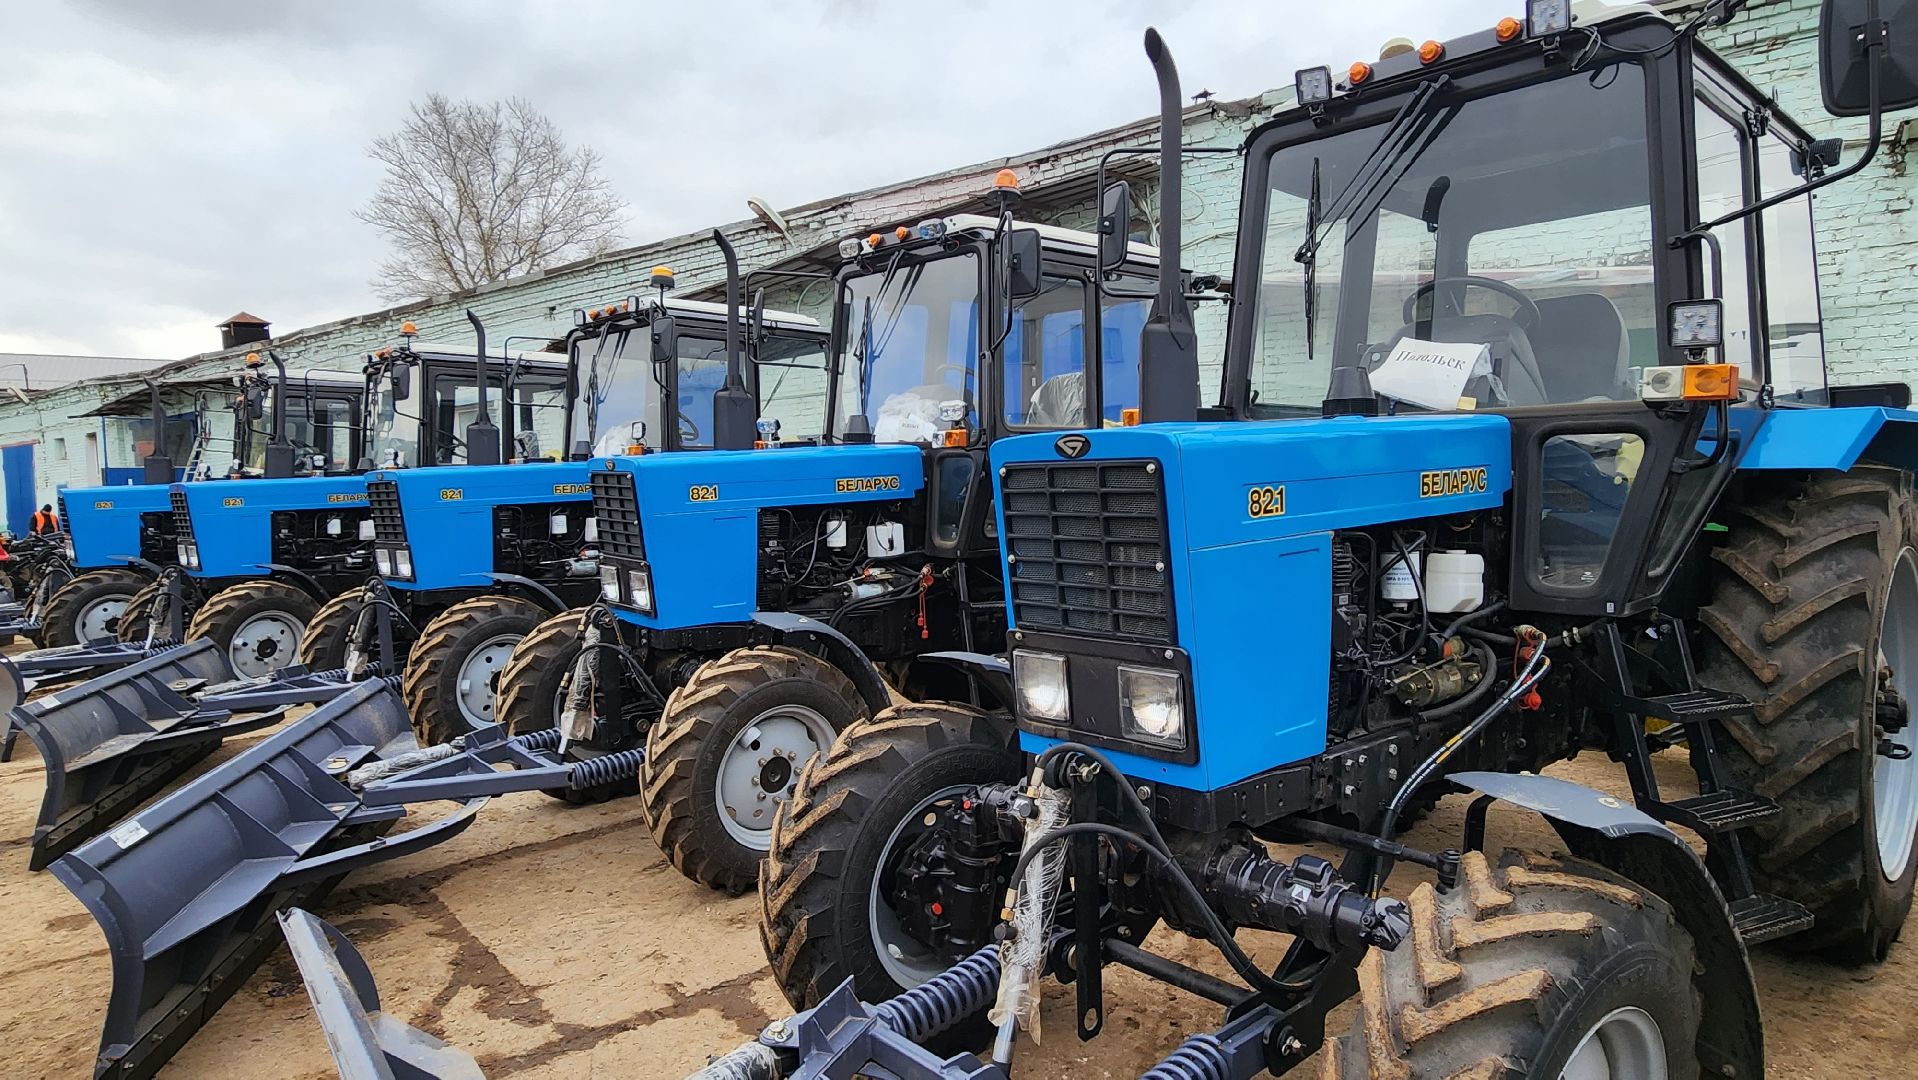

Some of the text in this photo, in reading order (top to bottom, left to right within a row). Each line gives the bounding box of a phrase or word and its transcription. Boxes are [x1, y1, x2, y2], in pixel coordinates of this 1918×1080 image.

[836, 476, 900, 492] БЕЛАРУС
[1420, 468, 1487, 498] БЕЛАРУС
[440, 489, 463, 500] 82.1
[690, 485, 718, 502] 82.1
[1249, 485, 1286, 518] 82.1
